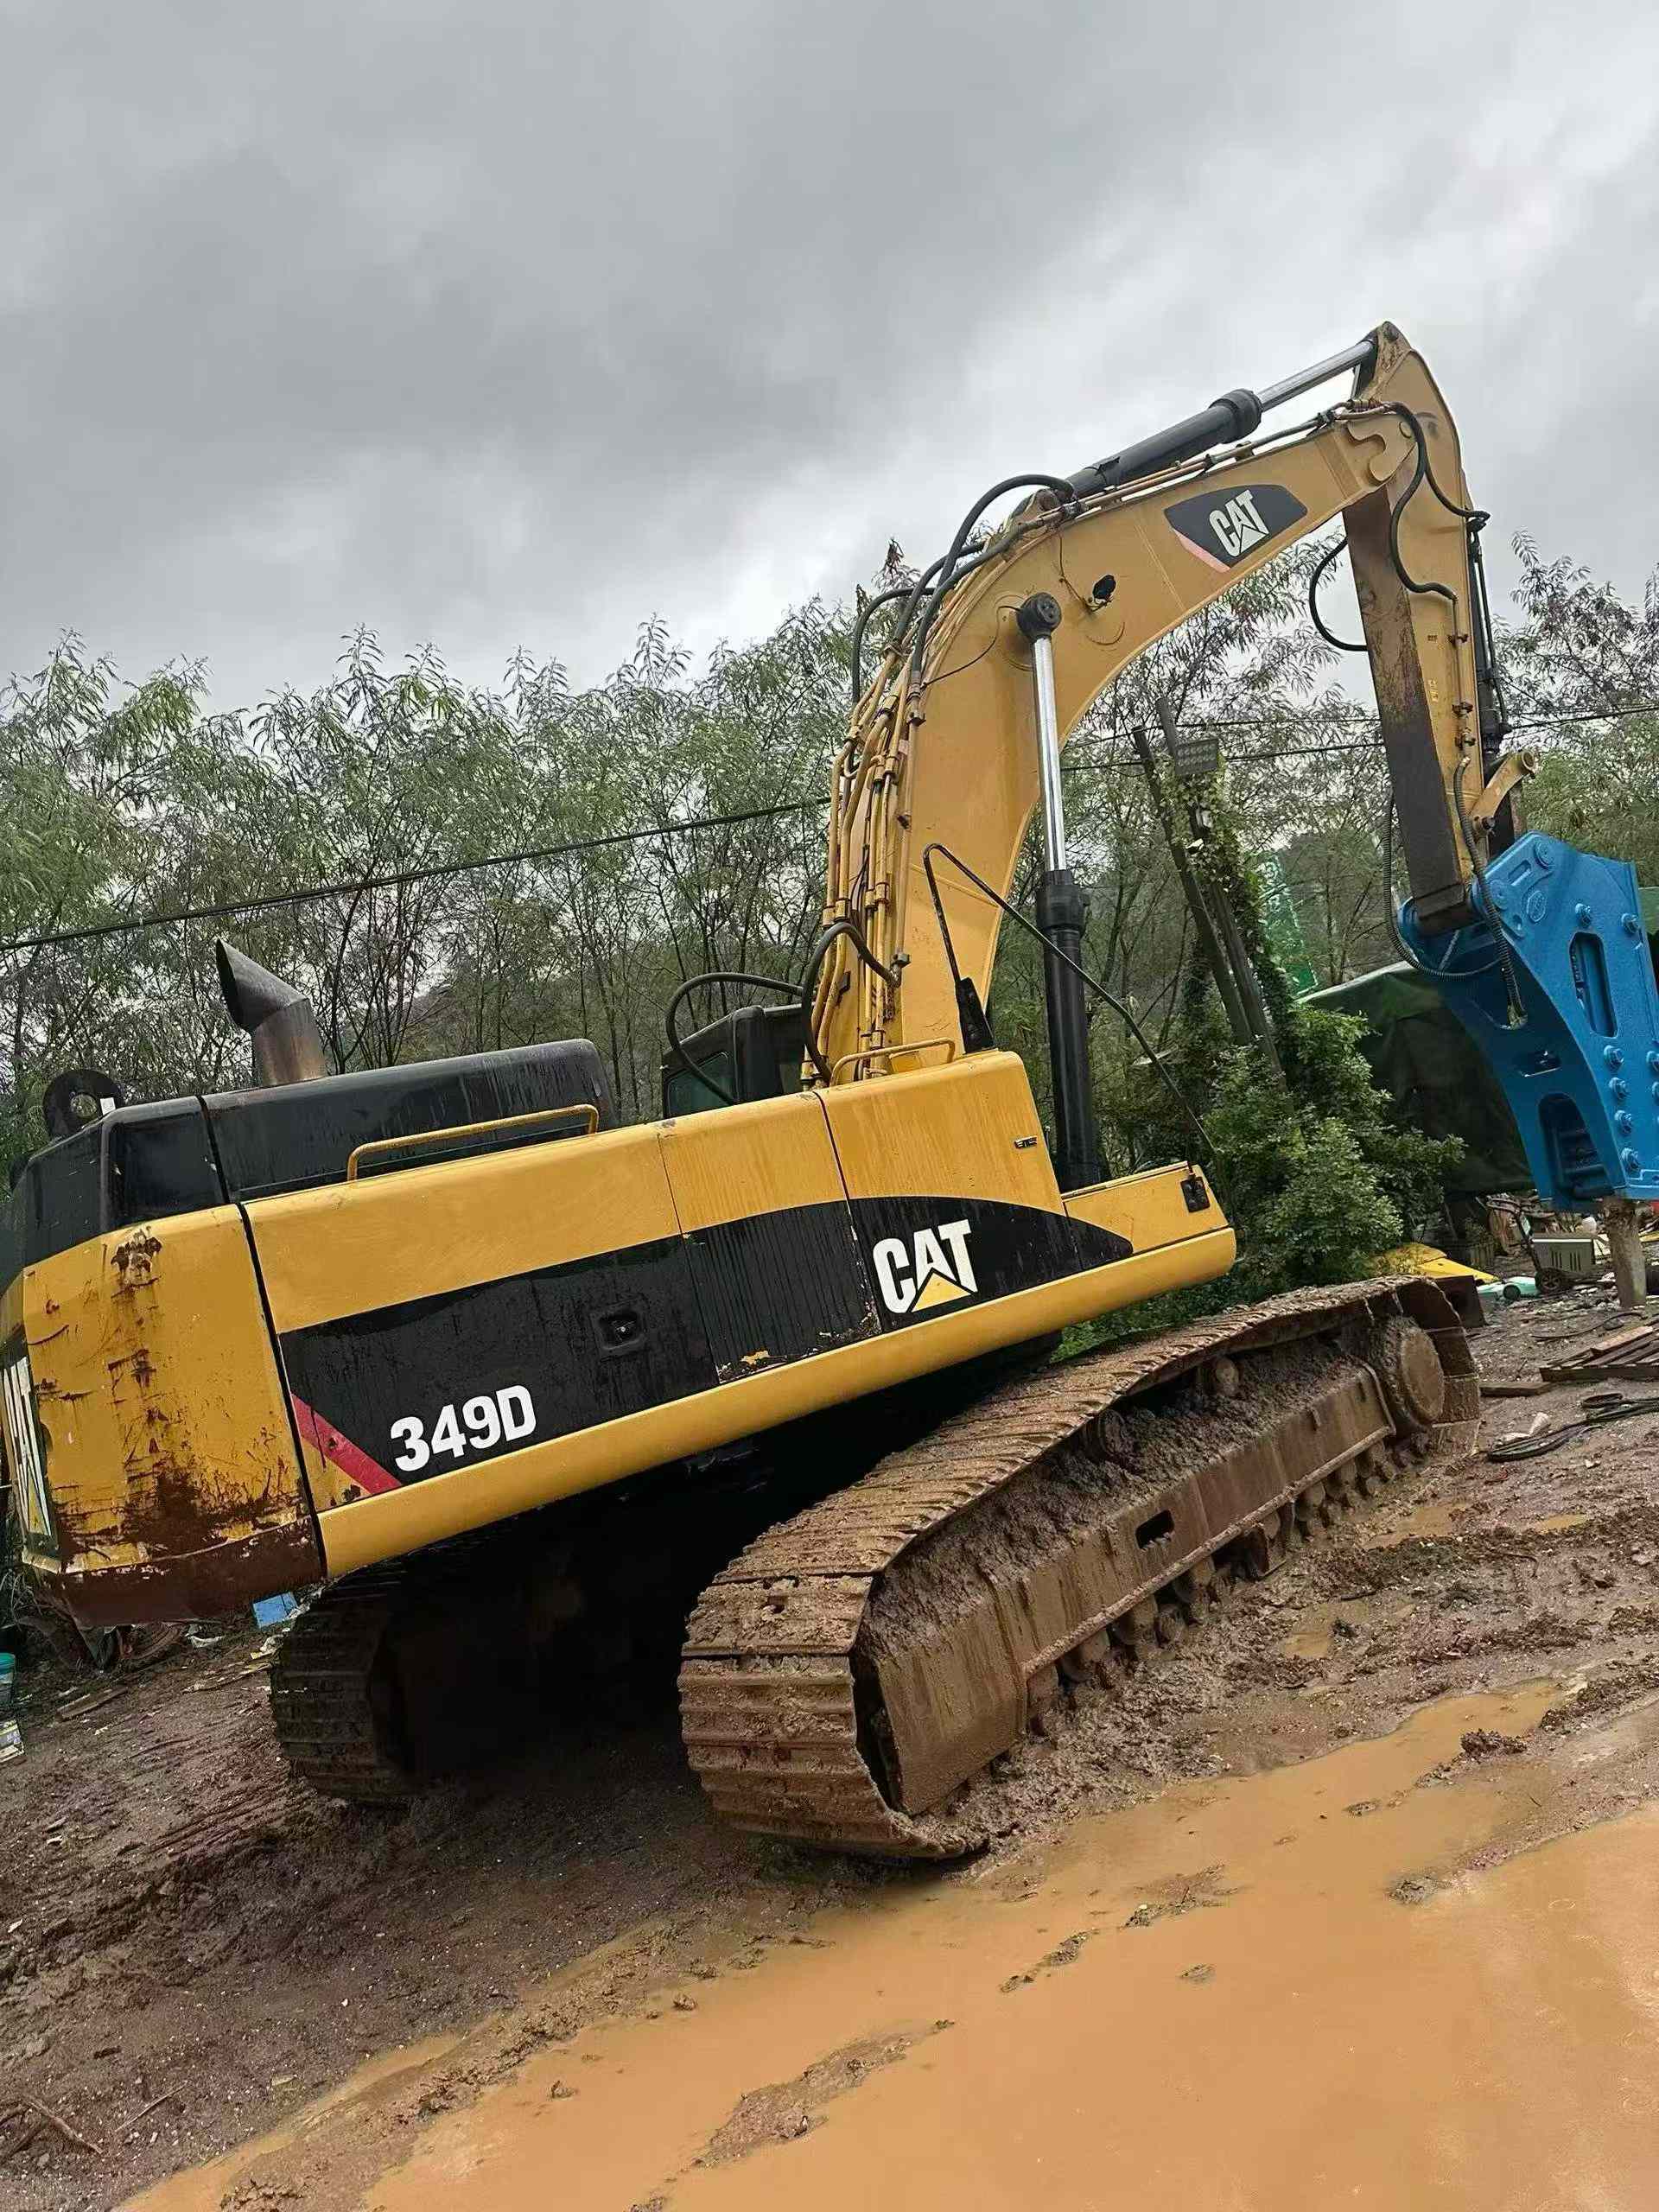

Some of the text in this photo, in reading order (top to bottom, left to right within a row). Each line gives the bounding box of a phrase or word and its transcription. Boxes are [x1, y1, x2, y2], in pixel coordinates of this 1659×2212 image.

[1210, 489, 1270, 557] CAT
[873, 1219, 978, 1313] CAT
[391, 1385, 537, 1471] 349D
